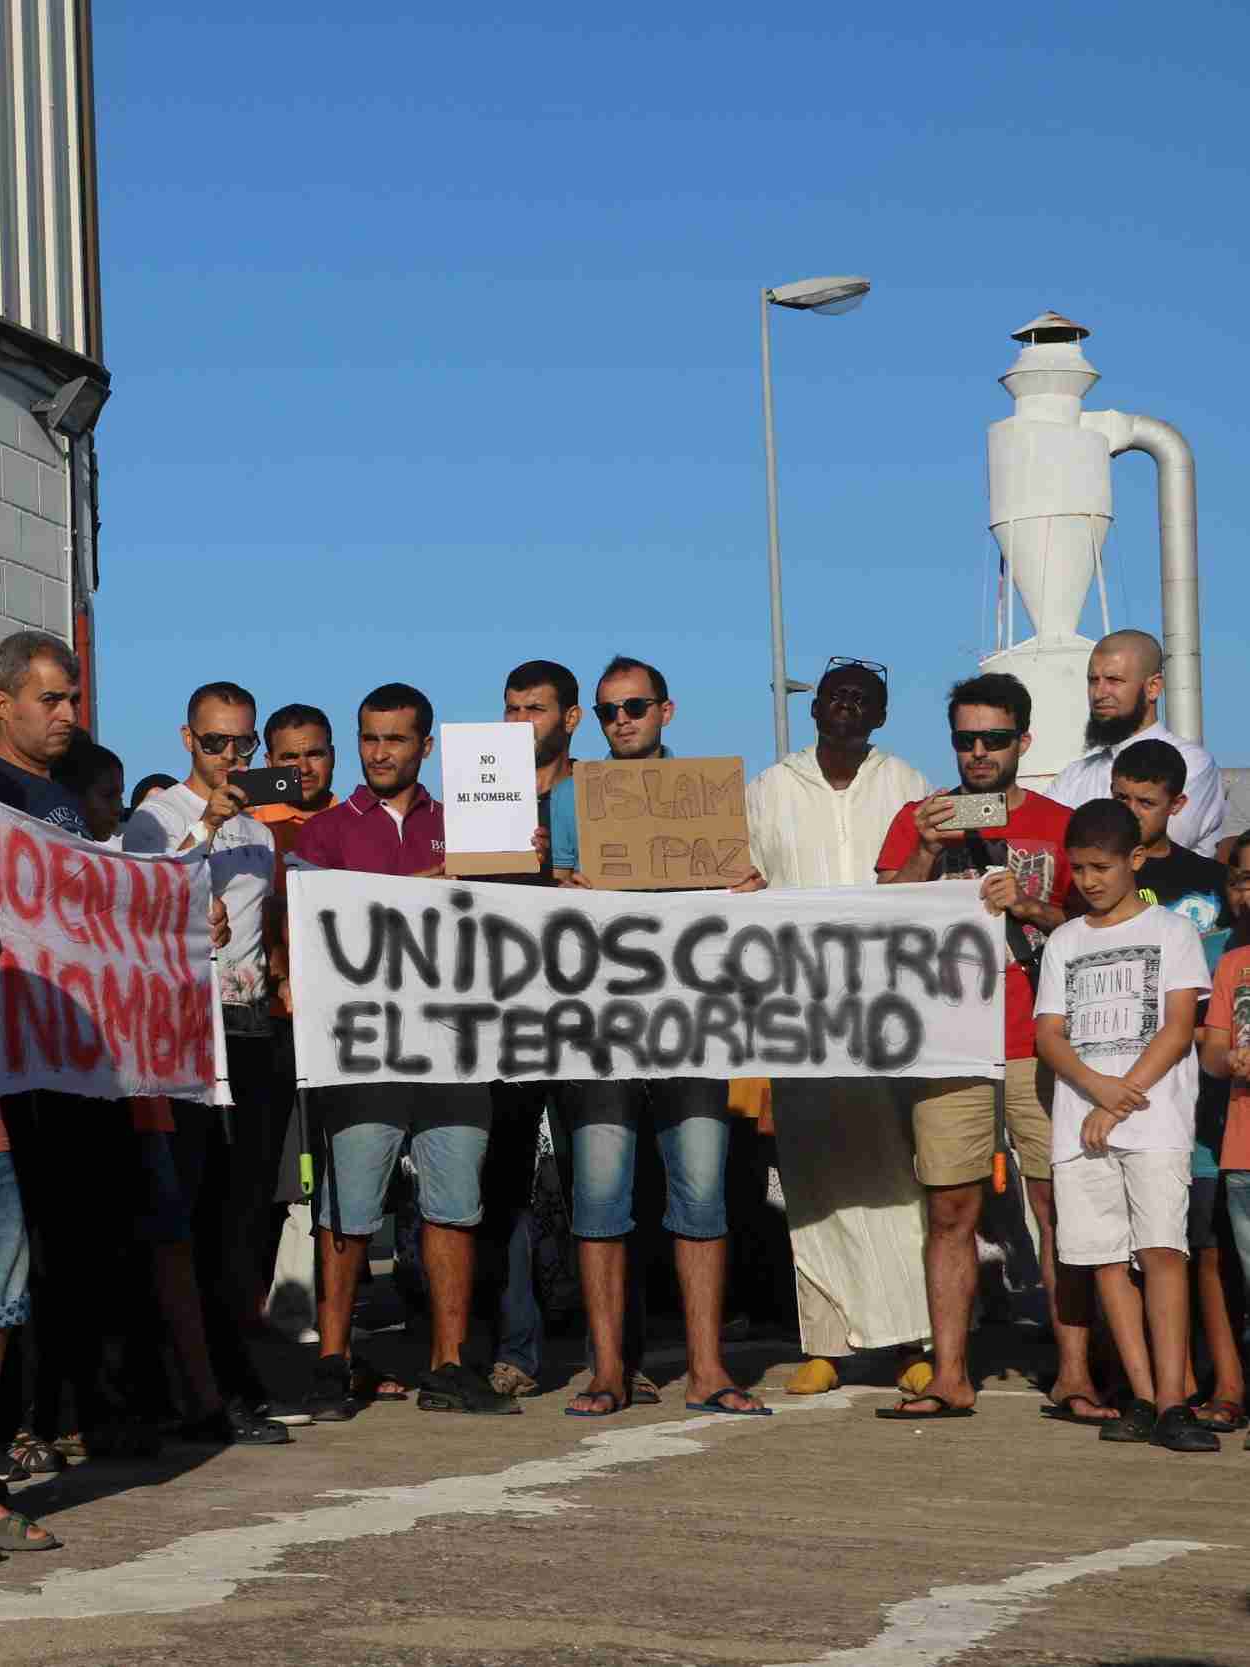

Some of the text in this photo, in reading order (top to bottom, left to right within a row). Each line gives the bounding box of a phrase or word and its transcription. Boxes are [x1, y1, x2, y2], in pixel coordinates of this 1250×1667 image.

[480, 754, 496, 765] NO
[481, 773, 496, 784] EN
[456, 791, 522, 802] MI NOMBRE
[647, 835, 749, 880] PAZ
[672, 915, 997, 1003] CONTRA
[333, 1001, 432, 1076] EL
